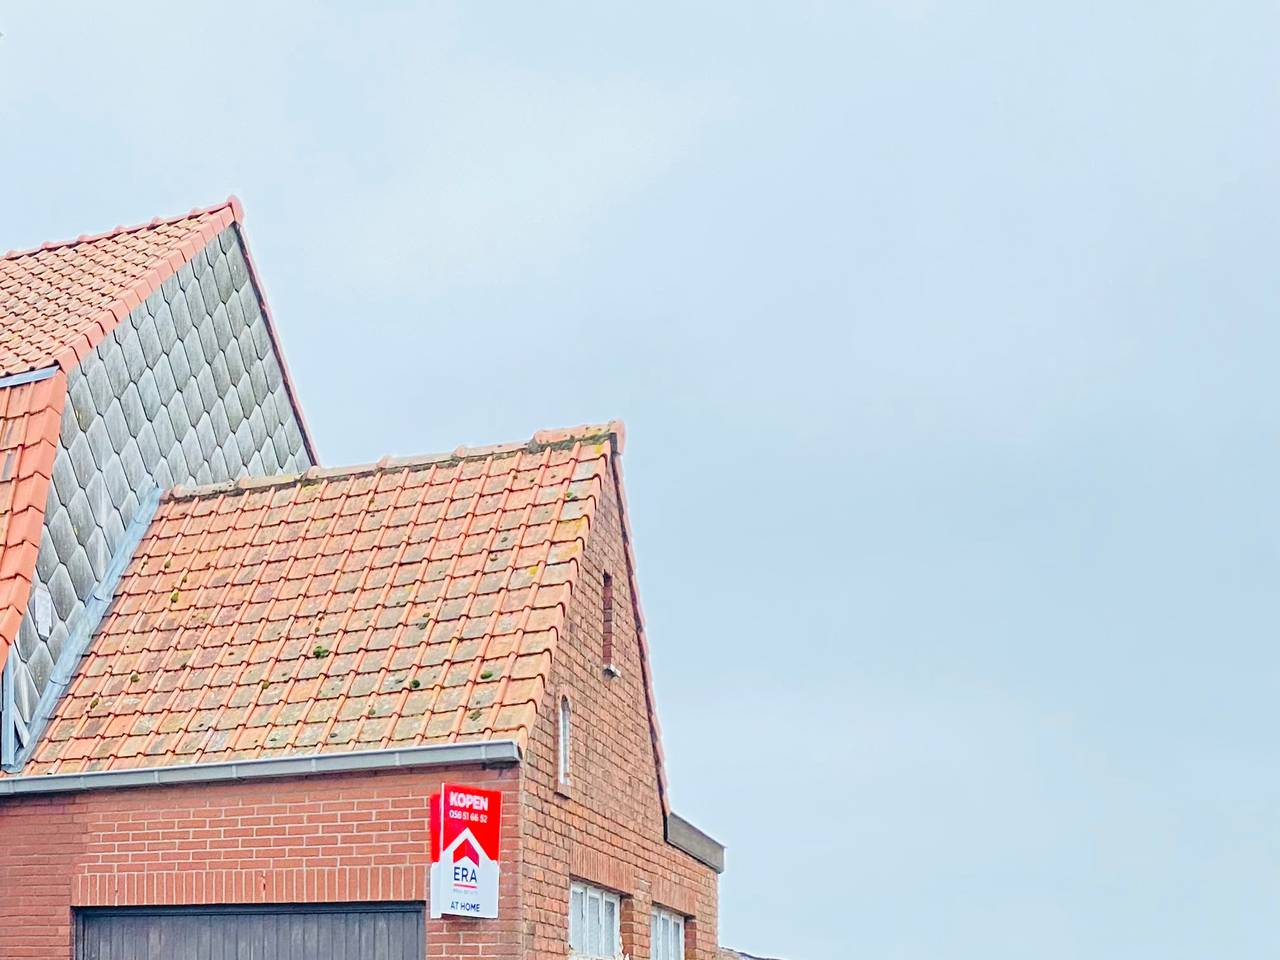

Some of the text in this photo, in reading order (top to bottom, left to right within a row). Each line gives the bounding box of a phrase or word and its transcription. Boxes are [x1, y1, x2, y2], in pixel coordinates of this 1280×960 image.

[449, 791, 488, 811] KOPEN
[462, 811, 470, 821] 51
[453, 866, 477, 882] ERA
[450, 901, 480, 912] AT HOME
